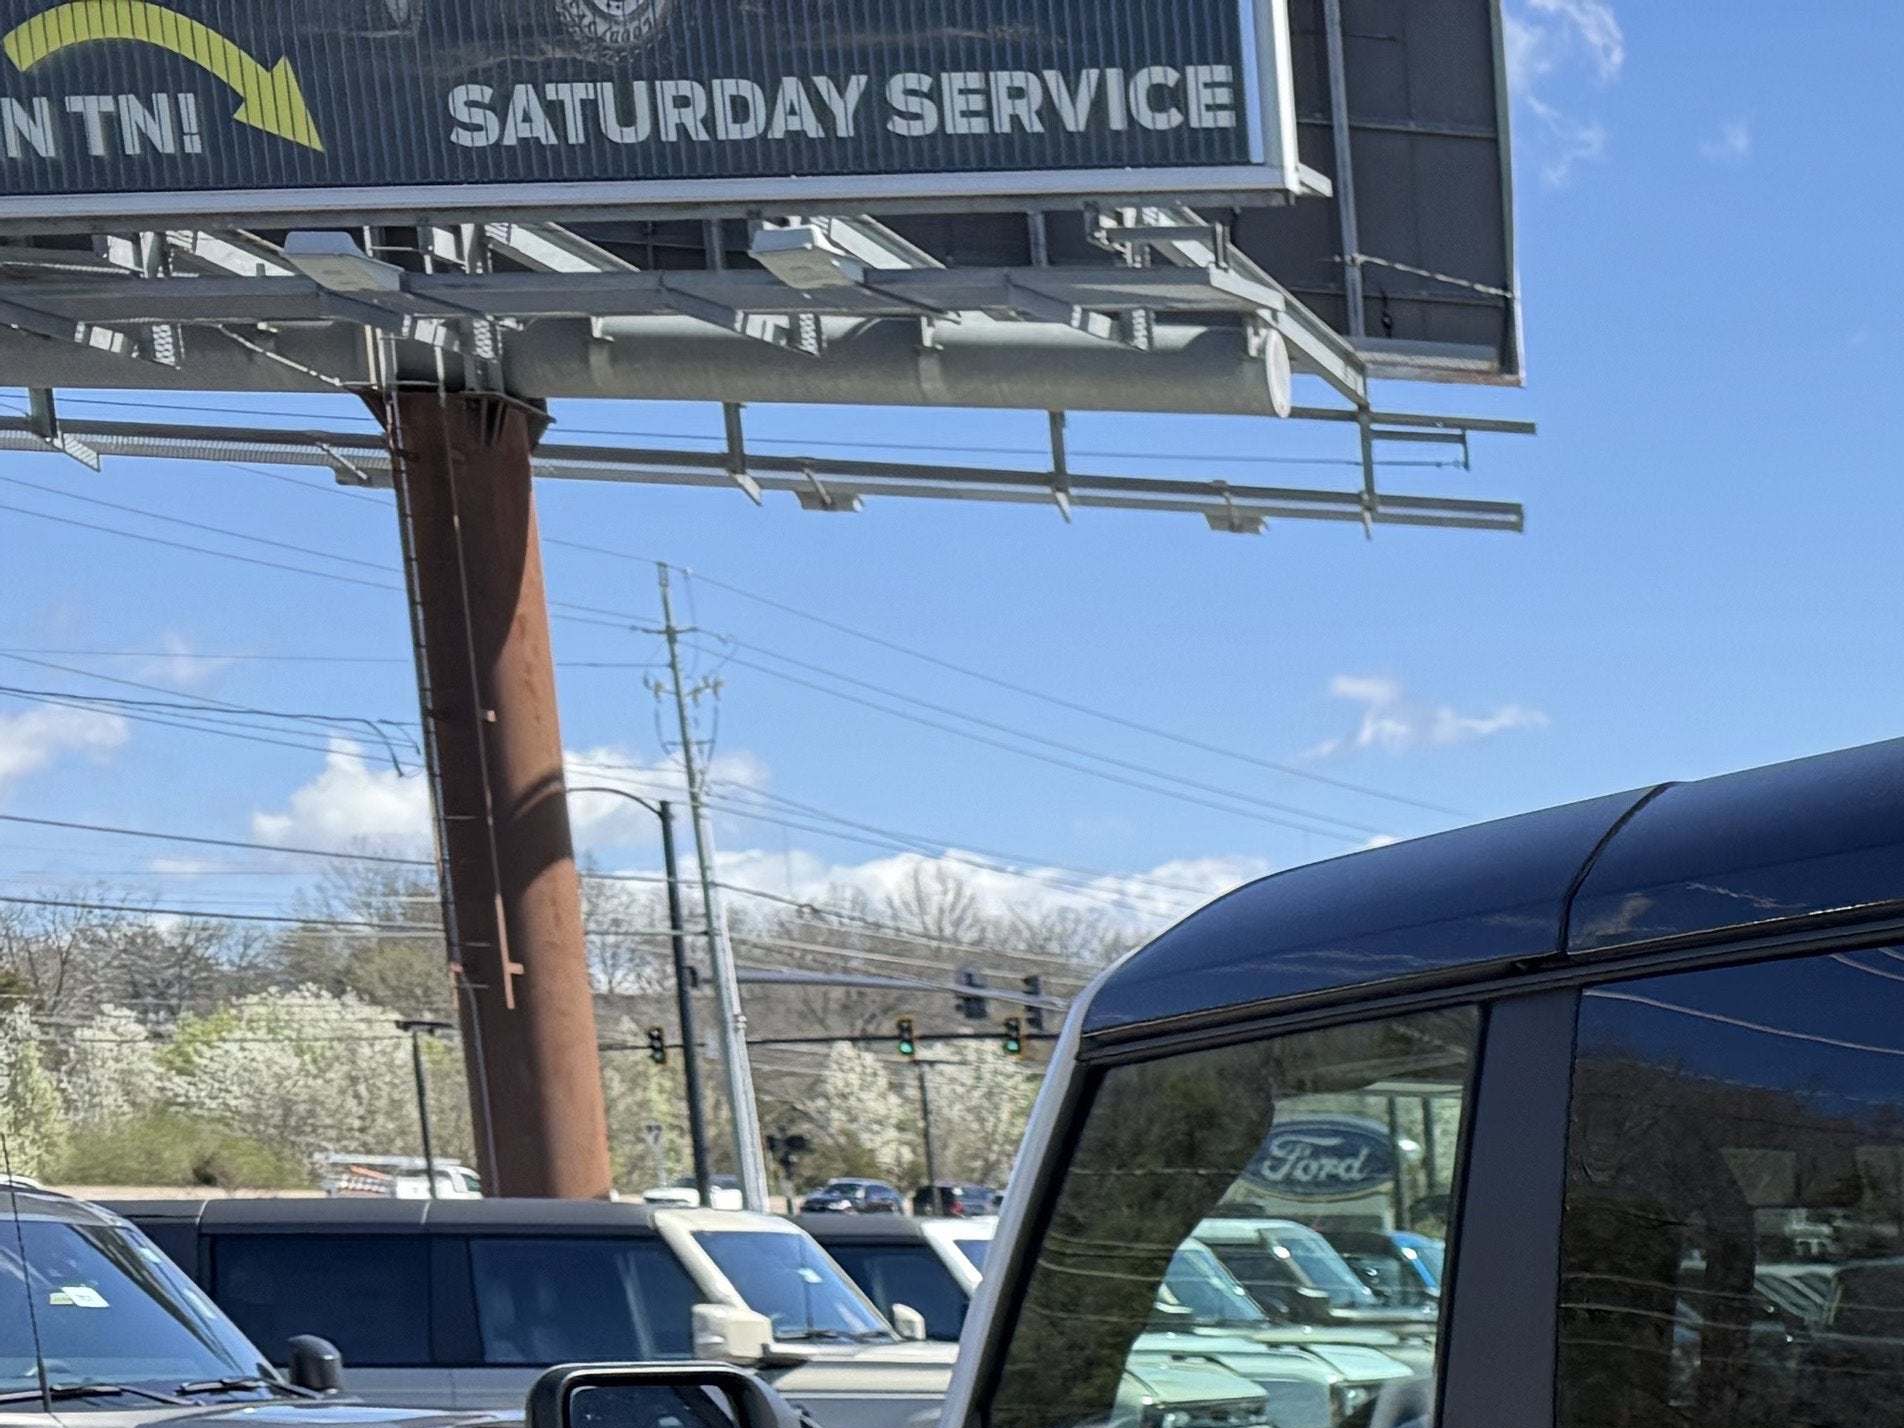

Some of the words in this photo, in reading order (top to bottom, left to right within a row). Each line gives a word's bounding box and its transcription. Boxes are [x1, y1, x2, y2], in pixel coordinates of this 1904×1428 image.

[65, 93, 202, 156] TN!
[448, 75, 868, 147] SATURDAY
[886, 64, 1236, 138] SERVICE
[1261, 1135, 1371, 1182] Ford
